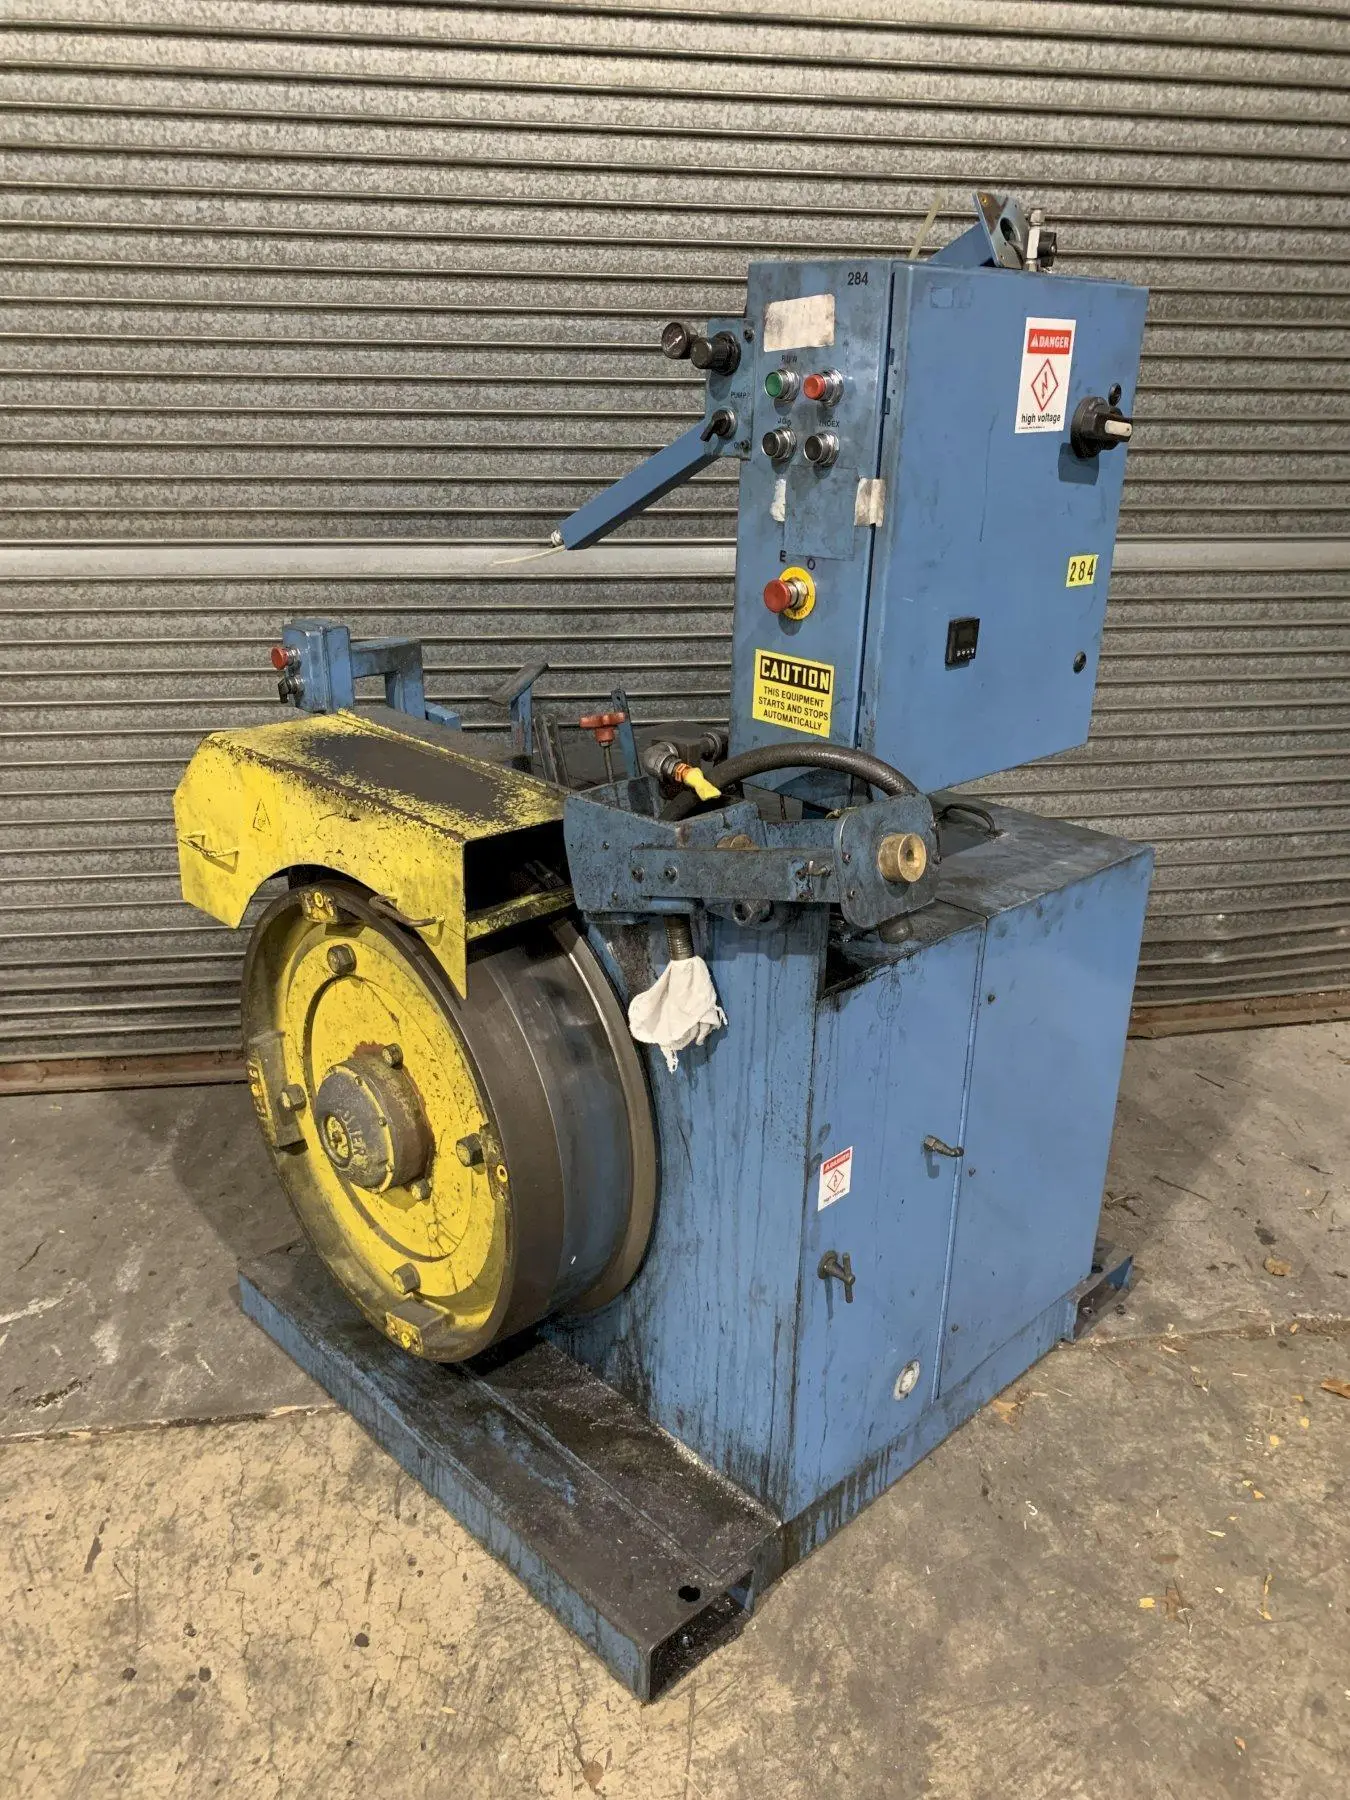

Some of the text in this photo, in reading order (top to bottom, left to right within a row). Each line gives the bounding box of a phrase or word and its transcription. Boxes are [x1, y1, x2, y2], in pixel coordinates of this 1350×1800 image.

[847, 271, 868, 286] 284
[1039, 335, 1070, 348] DANGER
[1021, 413, 1061, 425] high voltage
[779, 550, 787, 562] E
[1069, 558, 1095, 582] 284
[761, 658, 830, 690] CAUTION
[763, 686, 824, 708] THIS EQUIPMENT
[758, 696, 829, 721] STARTS AND STOPS
[763, 709, 822, 730] AUTOMATICALLY
